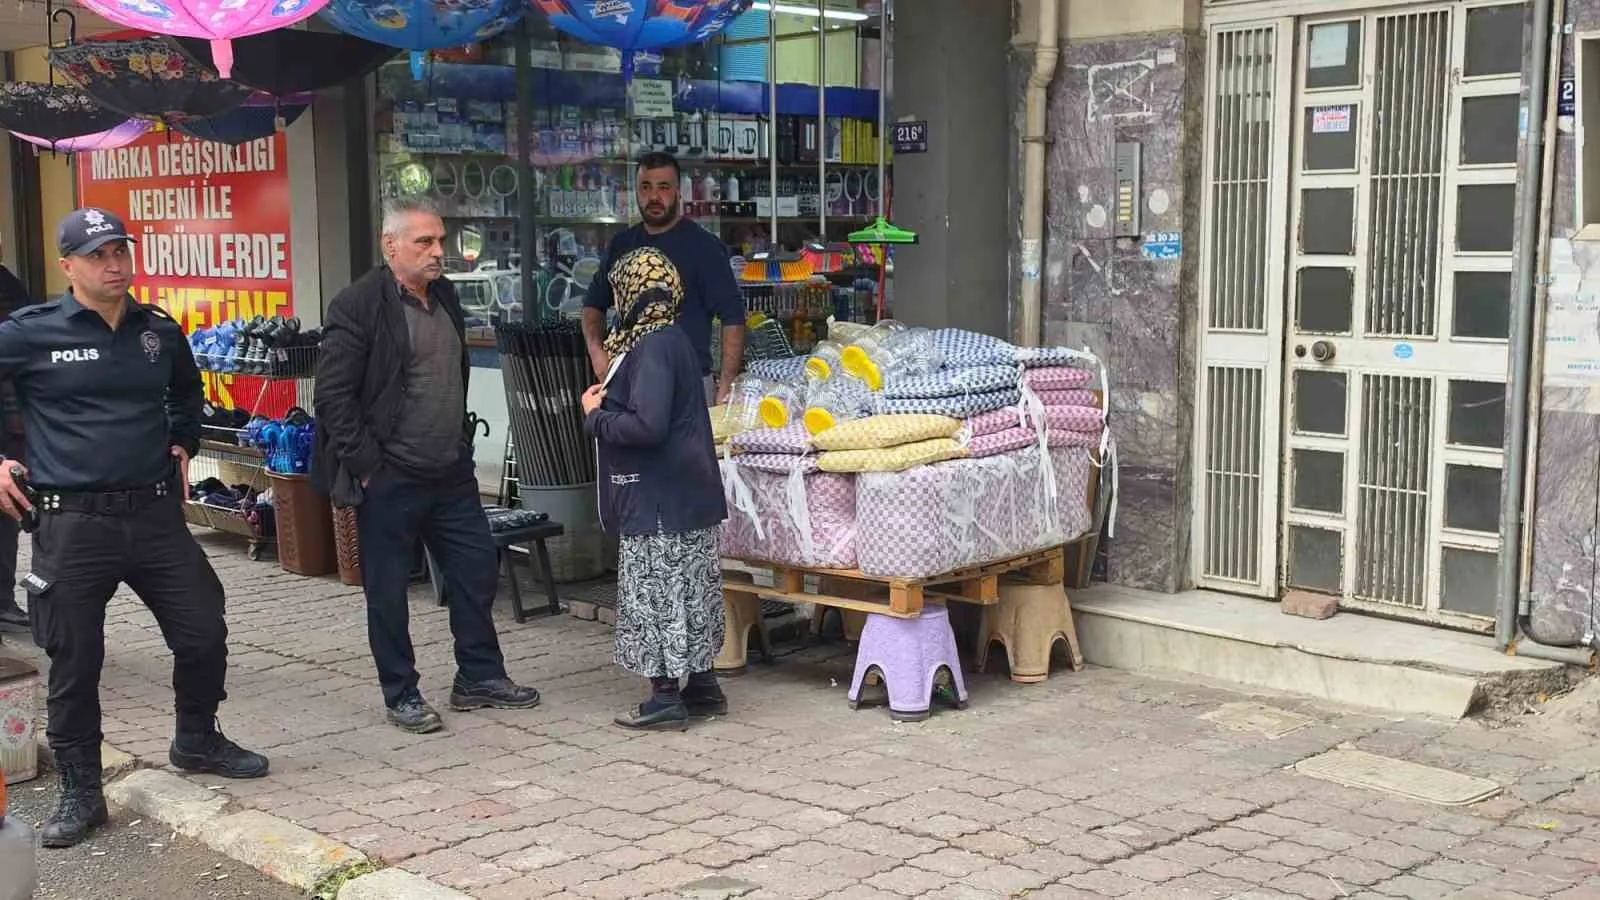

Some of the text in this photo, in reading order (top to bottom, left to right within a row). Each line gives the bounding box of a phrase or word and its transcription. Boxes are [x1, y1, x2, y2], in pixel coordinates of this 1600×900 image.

[92, 145, 153, 180] MARKA
[128, 180, 233, 221] NEDENİ İLE
[142, 226, 288, 280] ÜRÜNLERDE
